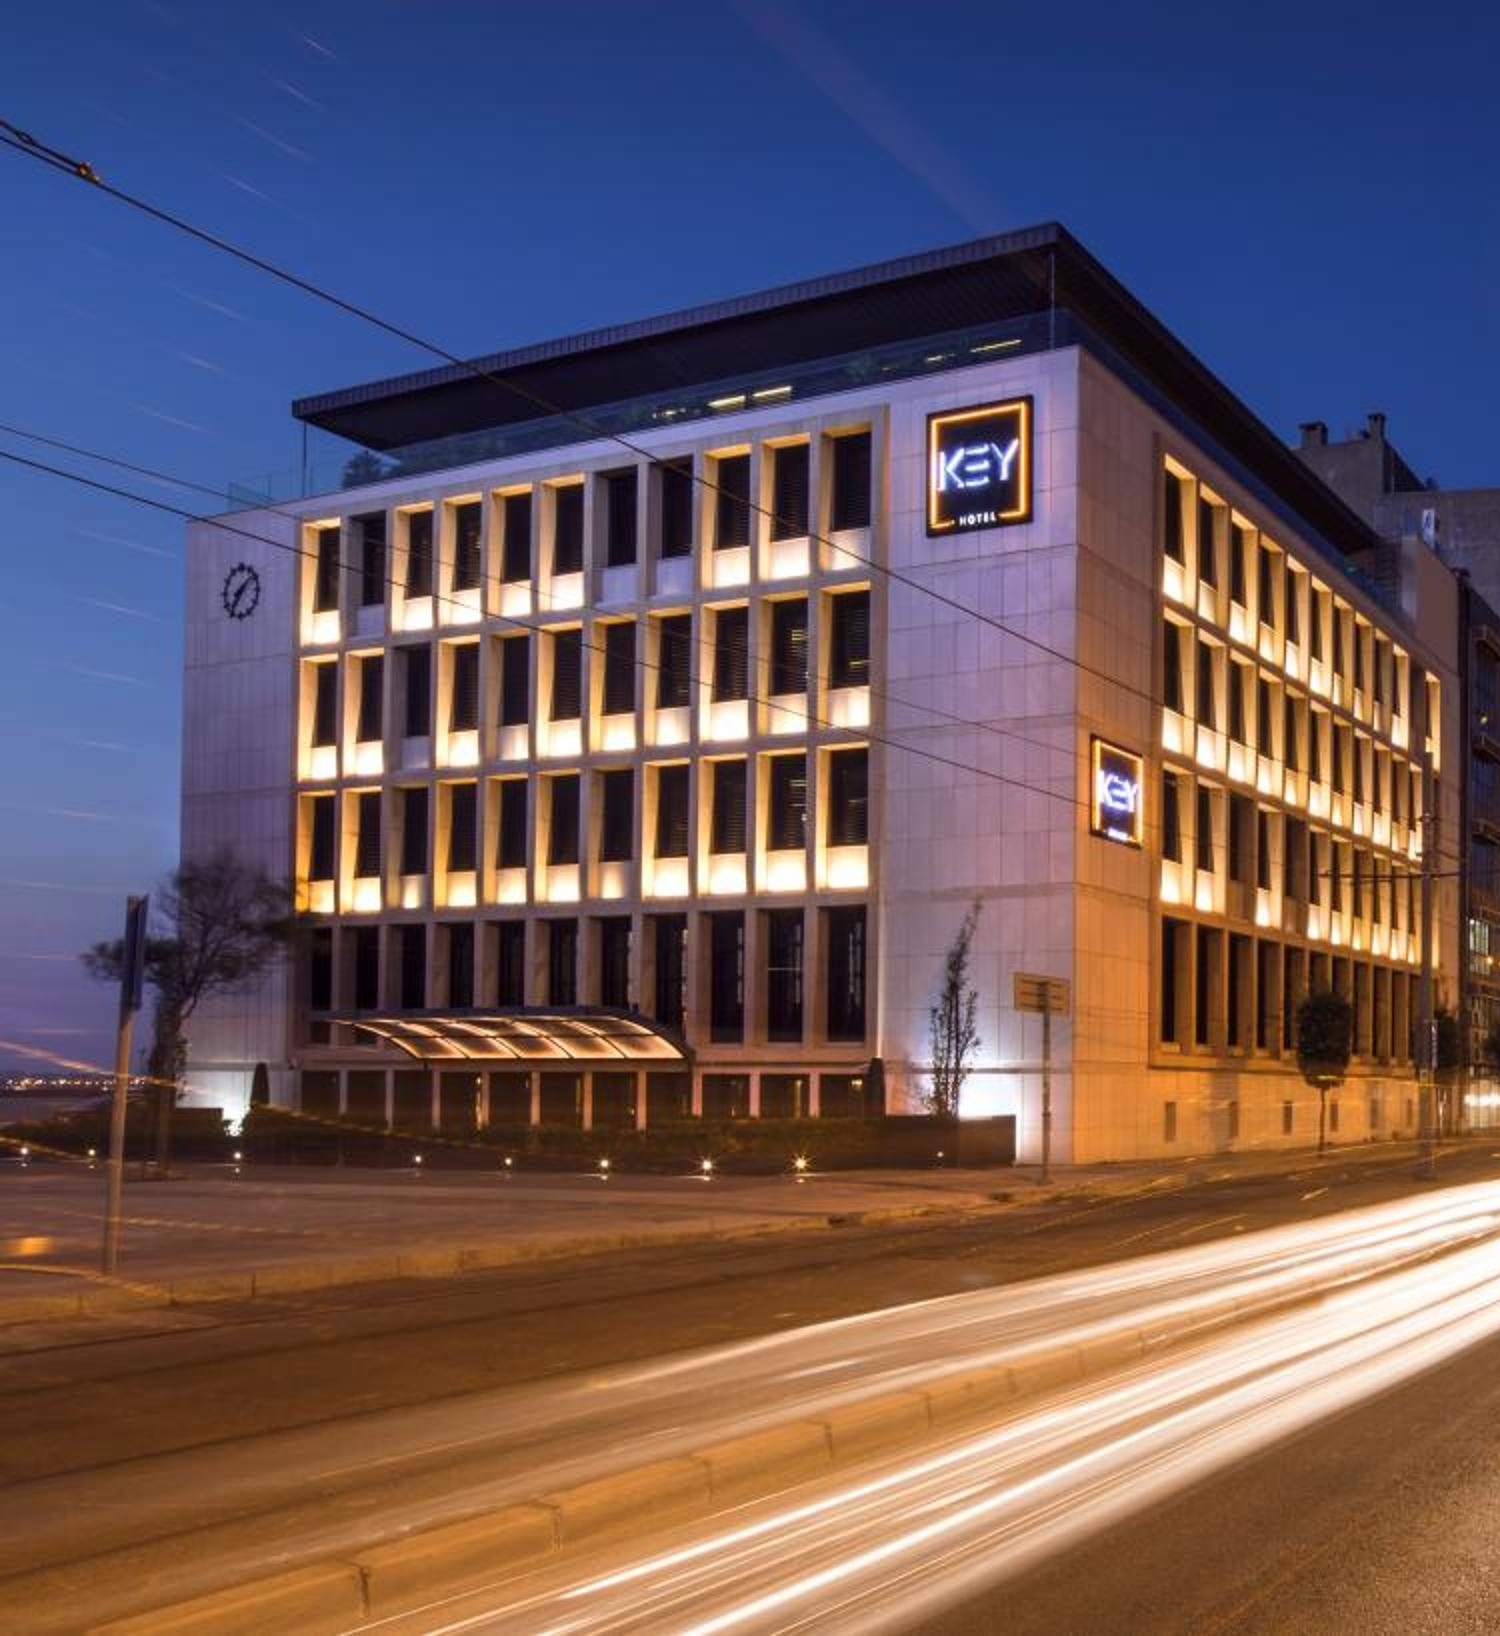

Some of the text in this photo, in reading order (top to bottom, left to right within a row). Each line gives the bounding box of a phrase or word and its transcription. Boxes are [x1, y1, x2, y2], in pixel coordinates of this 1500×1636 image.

[938, 438, 1018, 491] KEY
[959, 511, 997, 526] HOTEL
[1098, 769, 1139, 812] KEY
